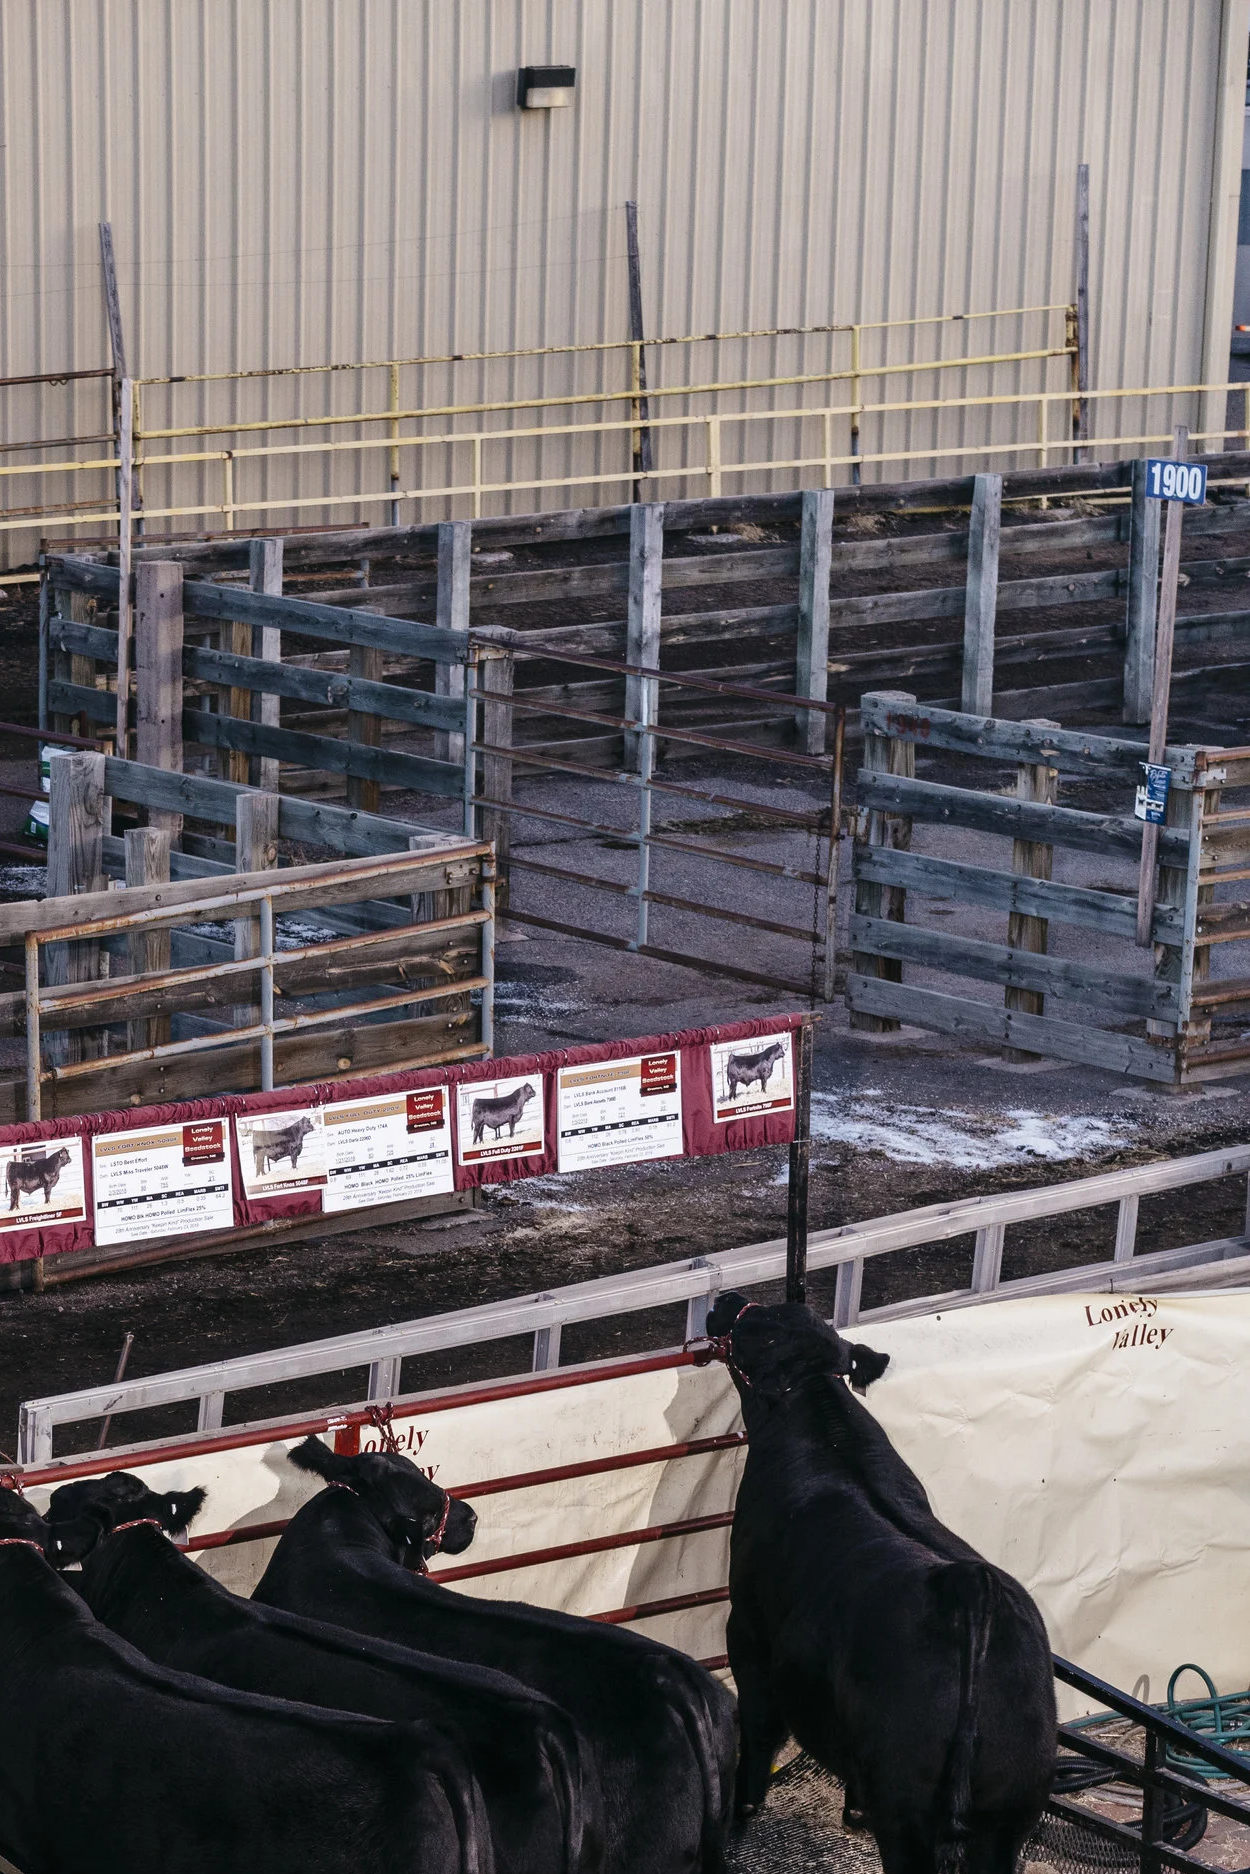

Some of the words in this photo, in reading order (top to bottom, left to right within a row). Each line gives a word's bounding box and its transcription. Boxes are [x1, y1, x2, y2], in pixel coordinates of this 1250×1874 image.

[1152, 462, 1202, 499] 1900
[642, 1074, 674, 1083] Seedstock
[414, 1094, 434, 1102] Lonely
[408, 1111, 441, 1120] Seedstock
[185, 1143, 221, 1153] Seedstock
[16, 1216, 28, 1224] LVLS
[29, 1213, 55, 1222] Freightliner
[1084, 1297, 1158, 1326] Lonely
